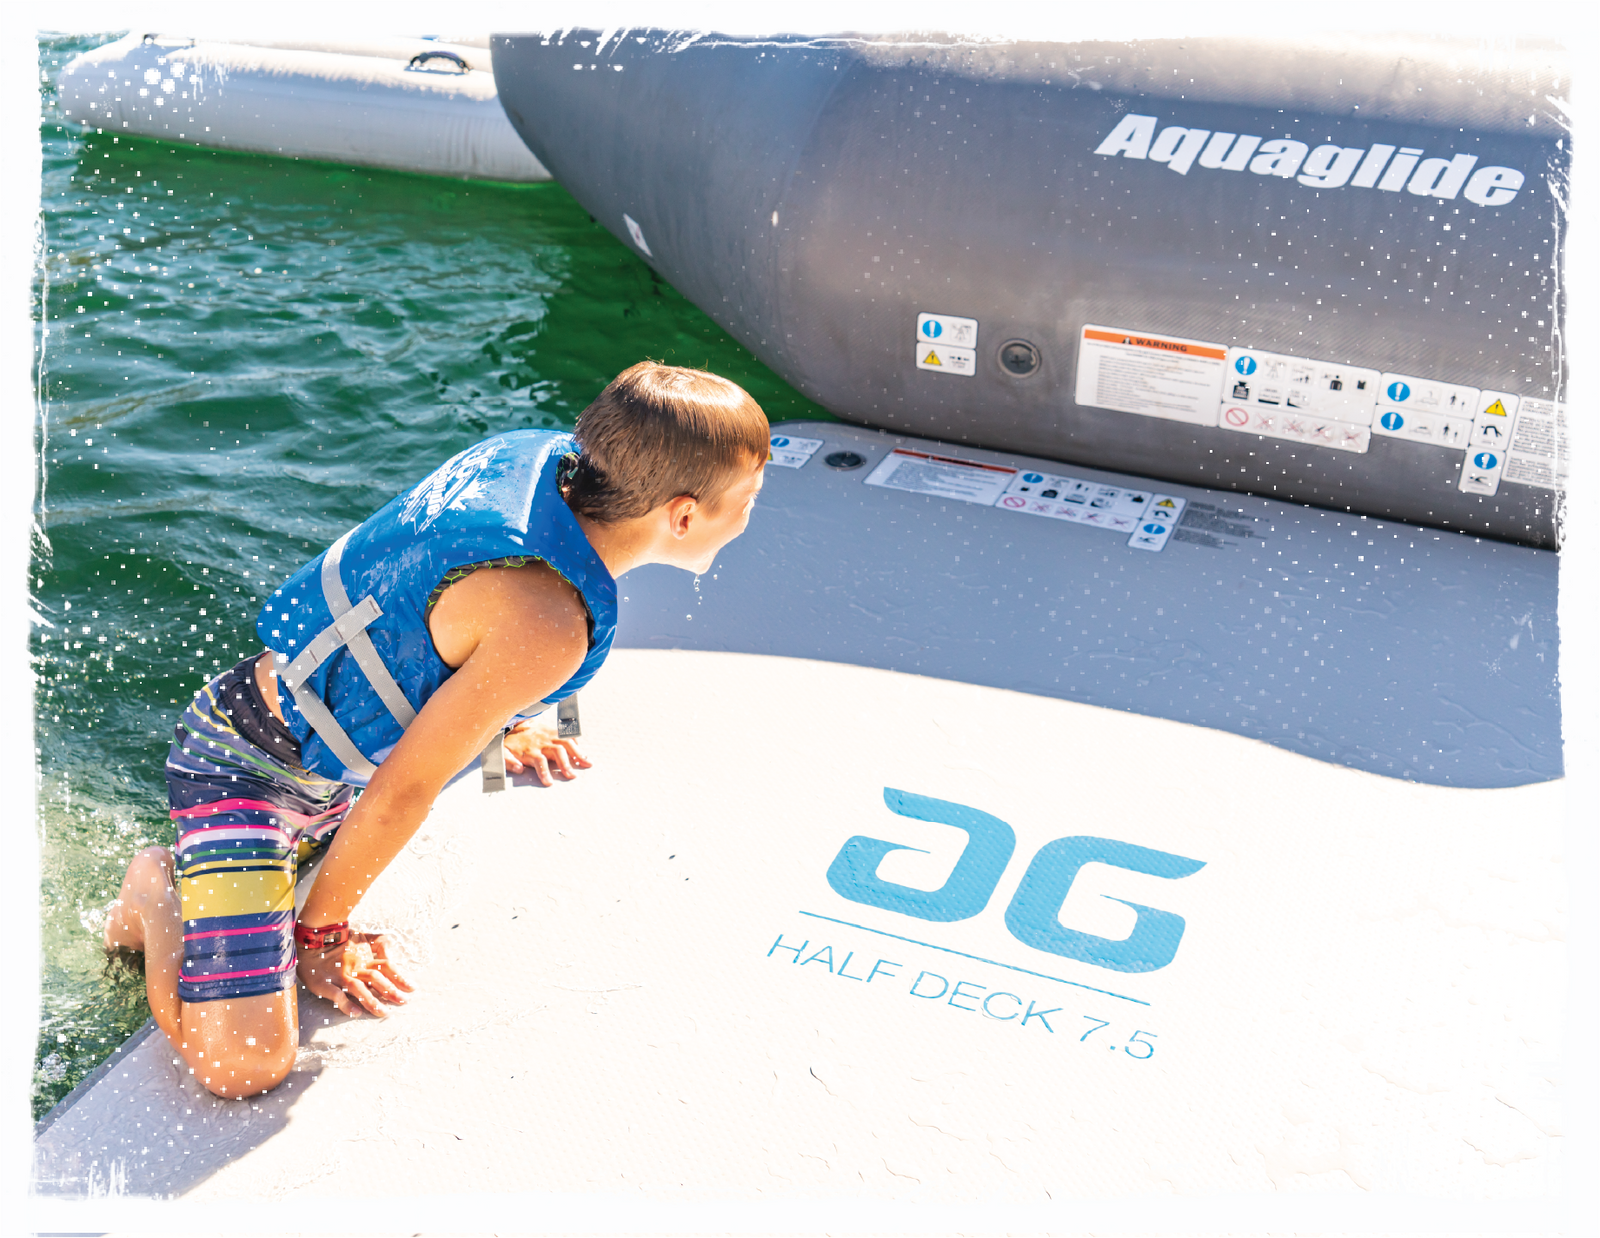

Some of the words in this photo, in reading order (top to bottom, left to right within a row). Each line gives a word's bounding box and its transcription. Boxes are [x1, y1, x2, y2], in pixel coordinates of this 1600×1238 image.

[1094, 113, 1525, 206] Aquaglide
[1135, 337, 1188, 352] WARNING
[767, 934, 903, 983] HALF
[910, 970, 1063, 1033] DECK
[1079, 1015, 1158, 1059] 7.5
